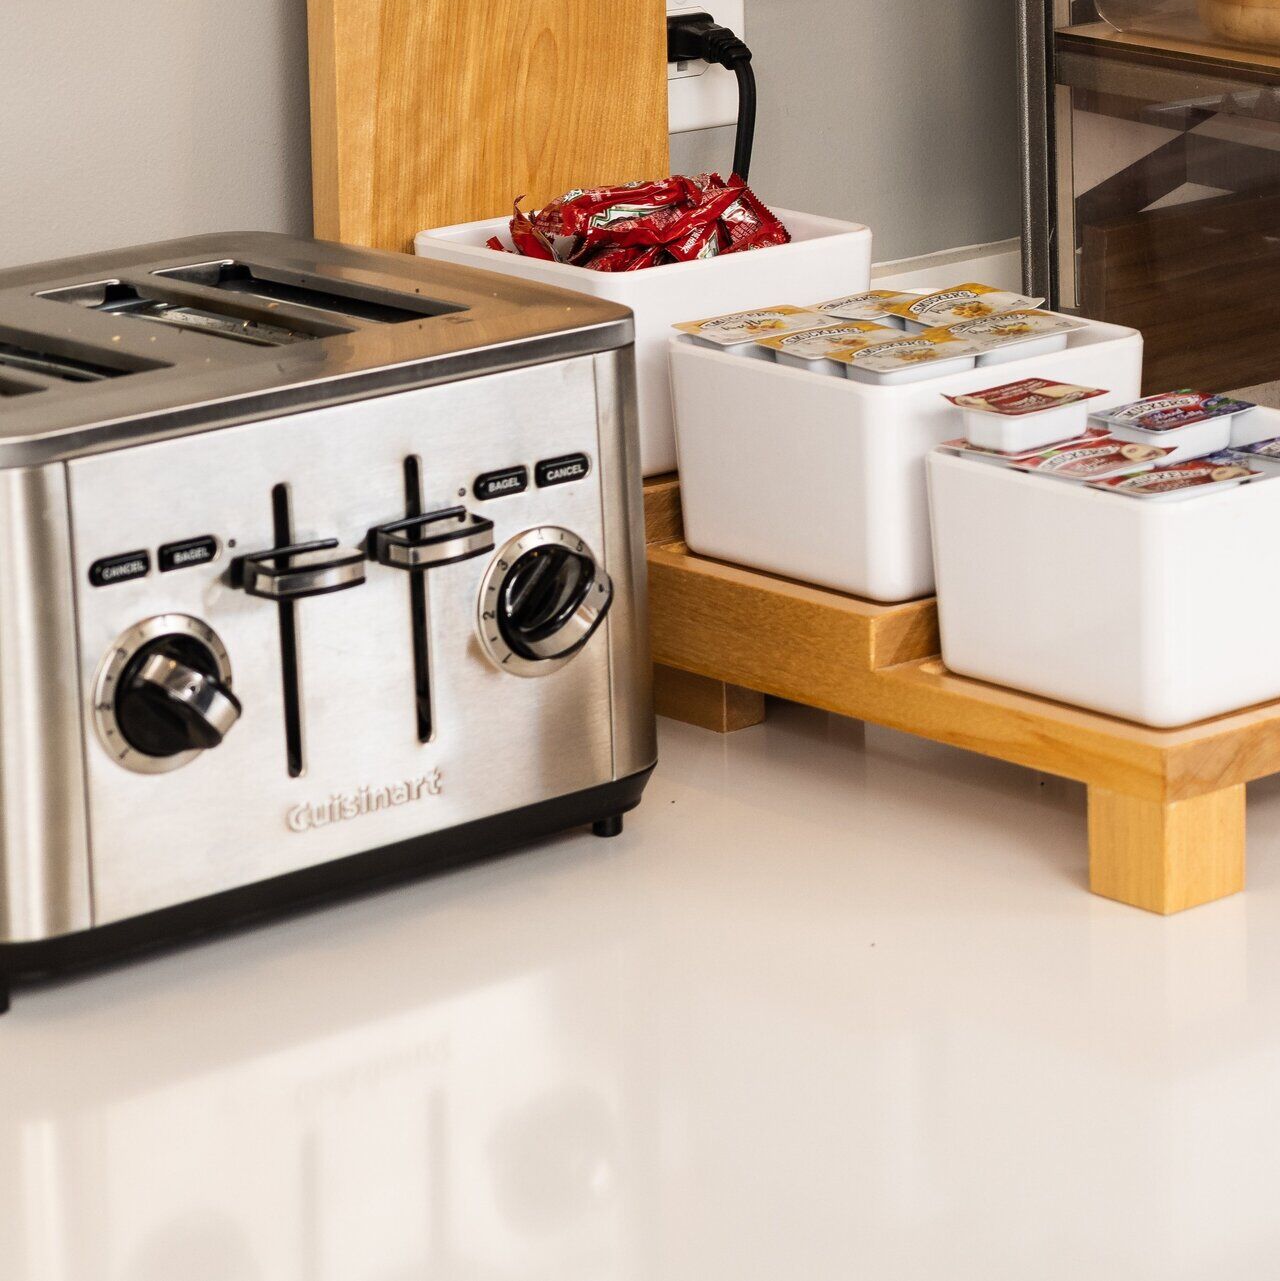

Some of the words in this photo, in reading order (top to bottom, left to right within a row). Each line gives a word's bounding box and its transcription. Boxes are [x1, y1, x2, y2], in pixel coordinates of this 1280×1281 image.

[545, 463, 585, 481] CANCEL
[488, 477, 521, 493] BAGEL
[173, 547, 210, 564] BAGEL
[101, 561, 147, 580] CANCEL
[496, 559, 508, 572] 3
[482, 610, 496, 621] 2
[286, 766, 444, 833] Cuisinart
